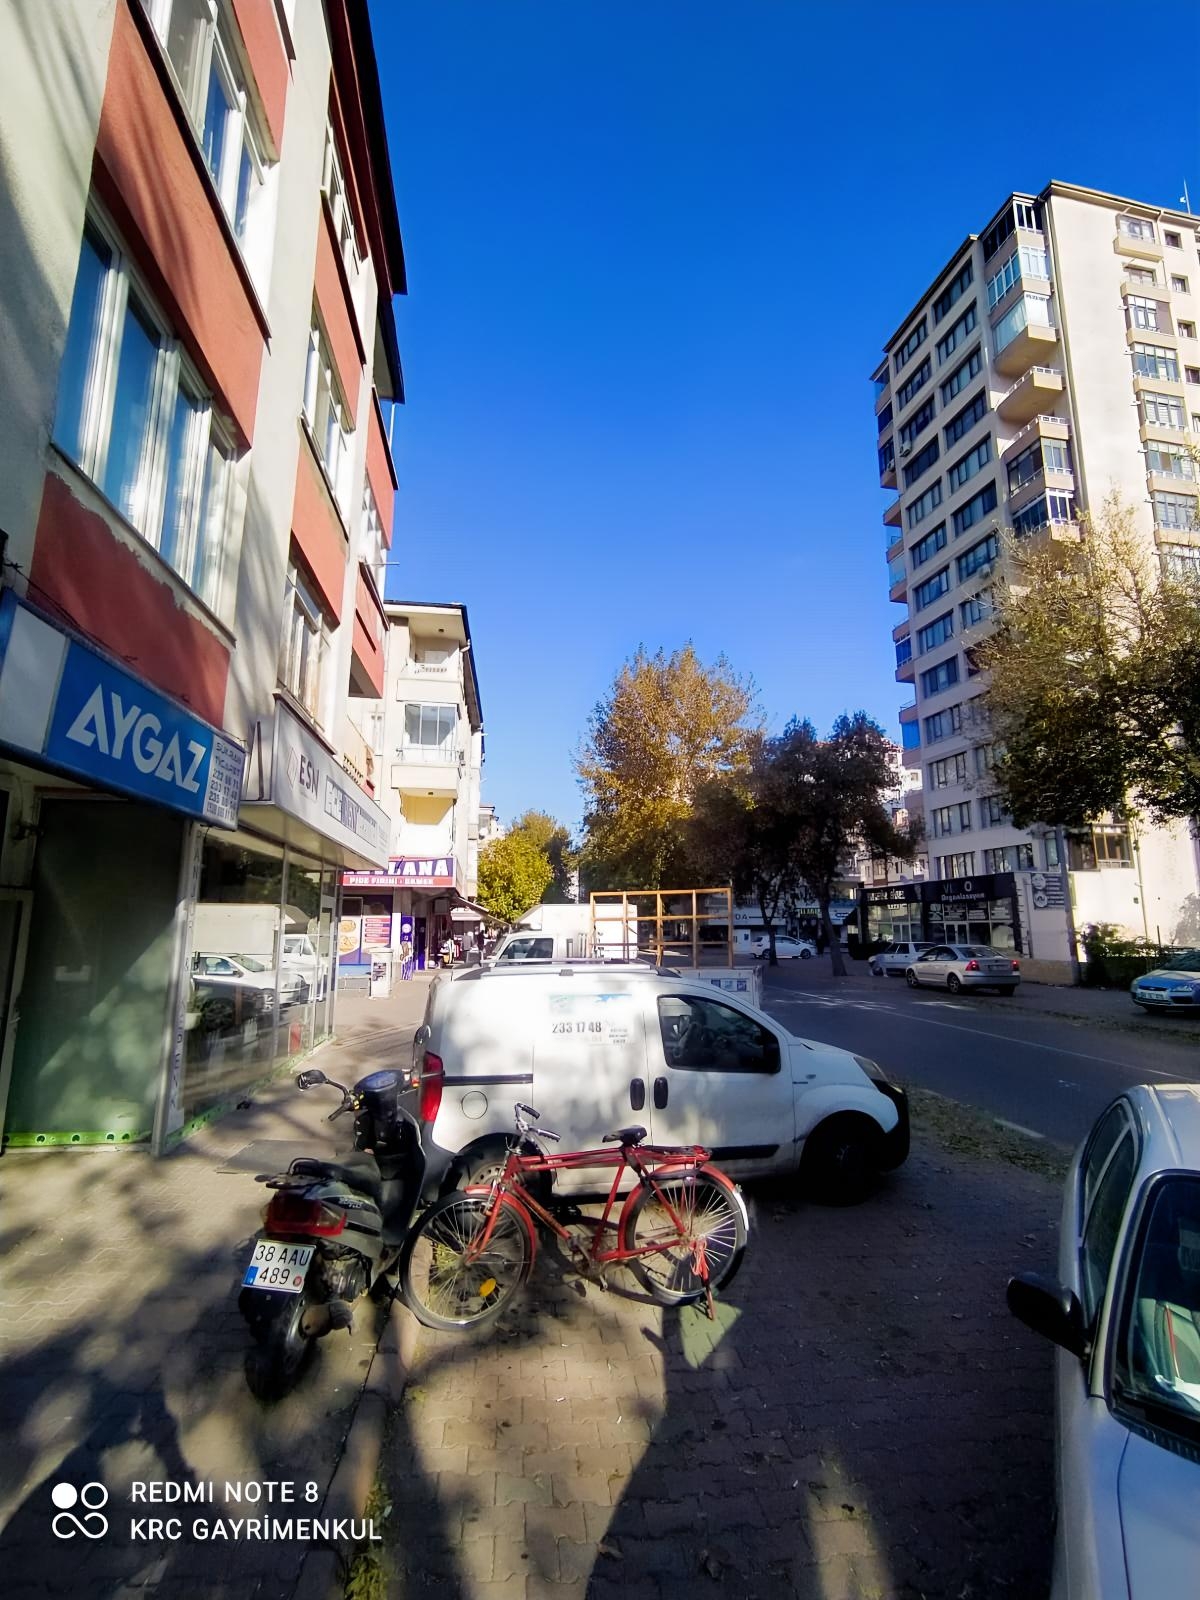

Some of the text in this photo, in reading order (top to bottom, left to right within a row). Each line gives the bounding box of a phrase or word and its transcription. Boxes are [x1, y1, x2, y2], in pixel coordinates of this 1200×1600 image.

[65, 683, 207, 793] AYGAZ
[300, 754, 320, 801] ESN
[552, 1021, 602, 1034] 233 17 48
[255, 1244, 311, 1267] 38 AAU
[259, 1266, 291, 1285] 489
